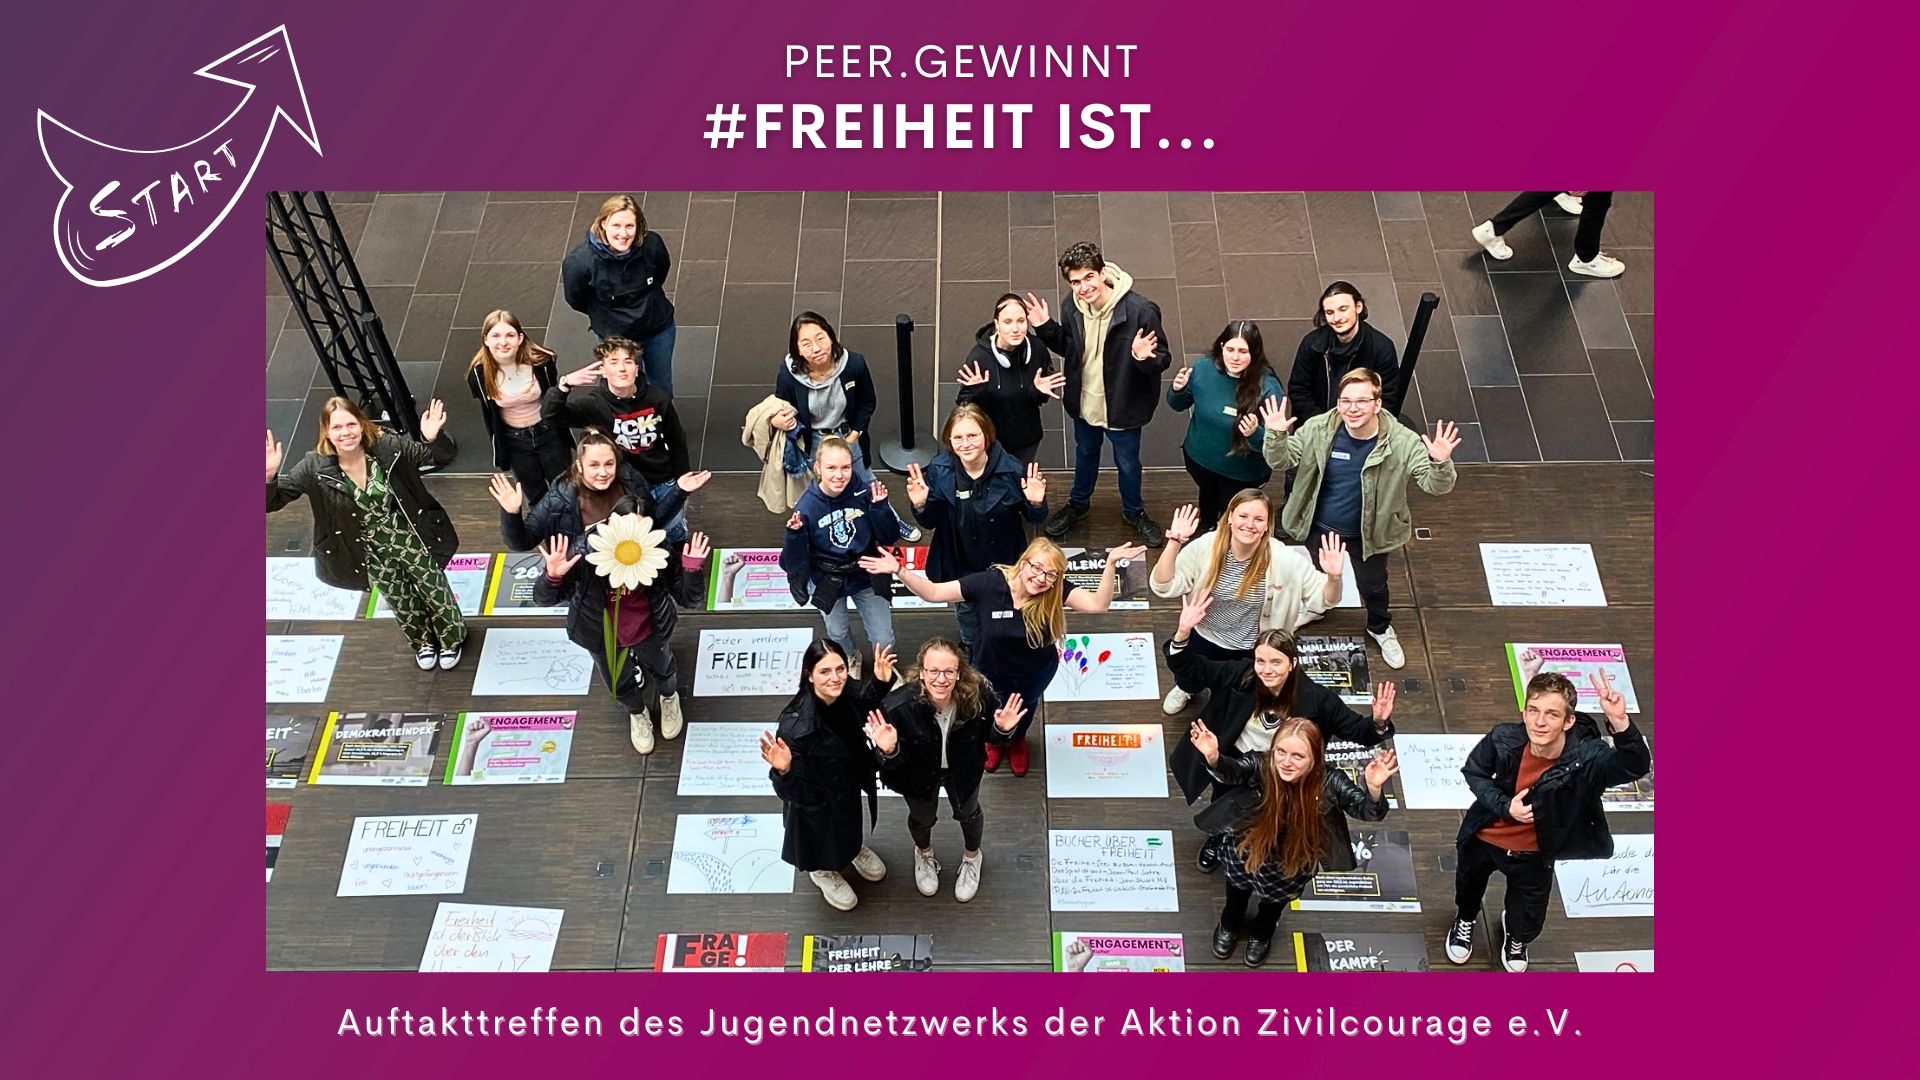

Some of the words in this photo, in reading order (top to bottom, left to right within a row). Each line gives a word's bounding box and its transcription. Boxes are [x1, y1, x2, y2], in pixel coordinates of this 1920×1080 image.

[707, 634, 743, 651] Jeder
[1538, 649, 1611, 657] ENGAGEMENT
[711, 651, 804, 670] FREIHEIT
[489, 716, 564, 725] ENGAGEMENT
[335, 726, 434, 740] DEMOKRATIEINDEX
[361, 819, 449, 839] FREIHEIT
[1101, 847, 1157, 859] FREIHEIT
[1089, 939, 1170, 949] ENGAGEMENT
[1325, 939, 1356, 952] DER
[828, 947, 880, 961] FREIHEIT
[854, 960, 892, 971] LEHRE
[1330, 956, 1379, 971] KAMPF
